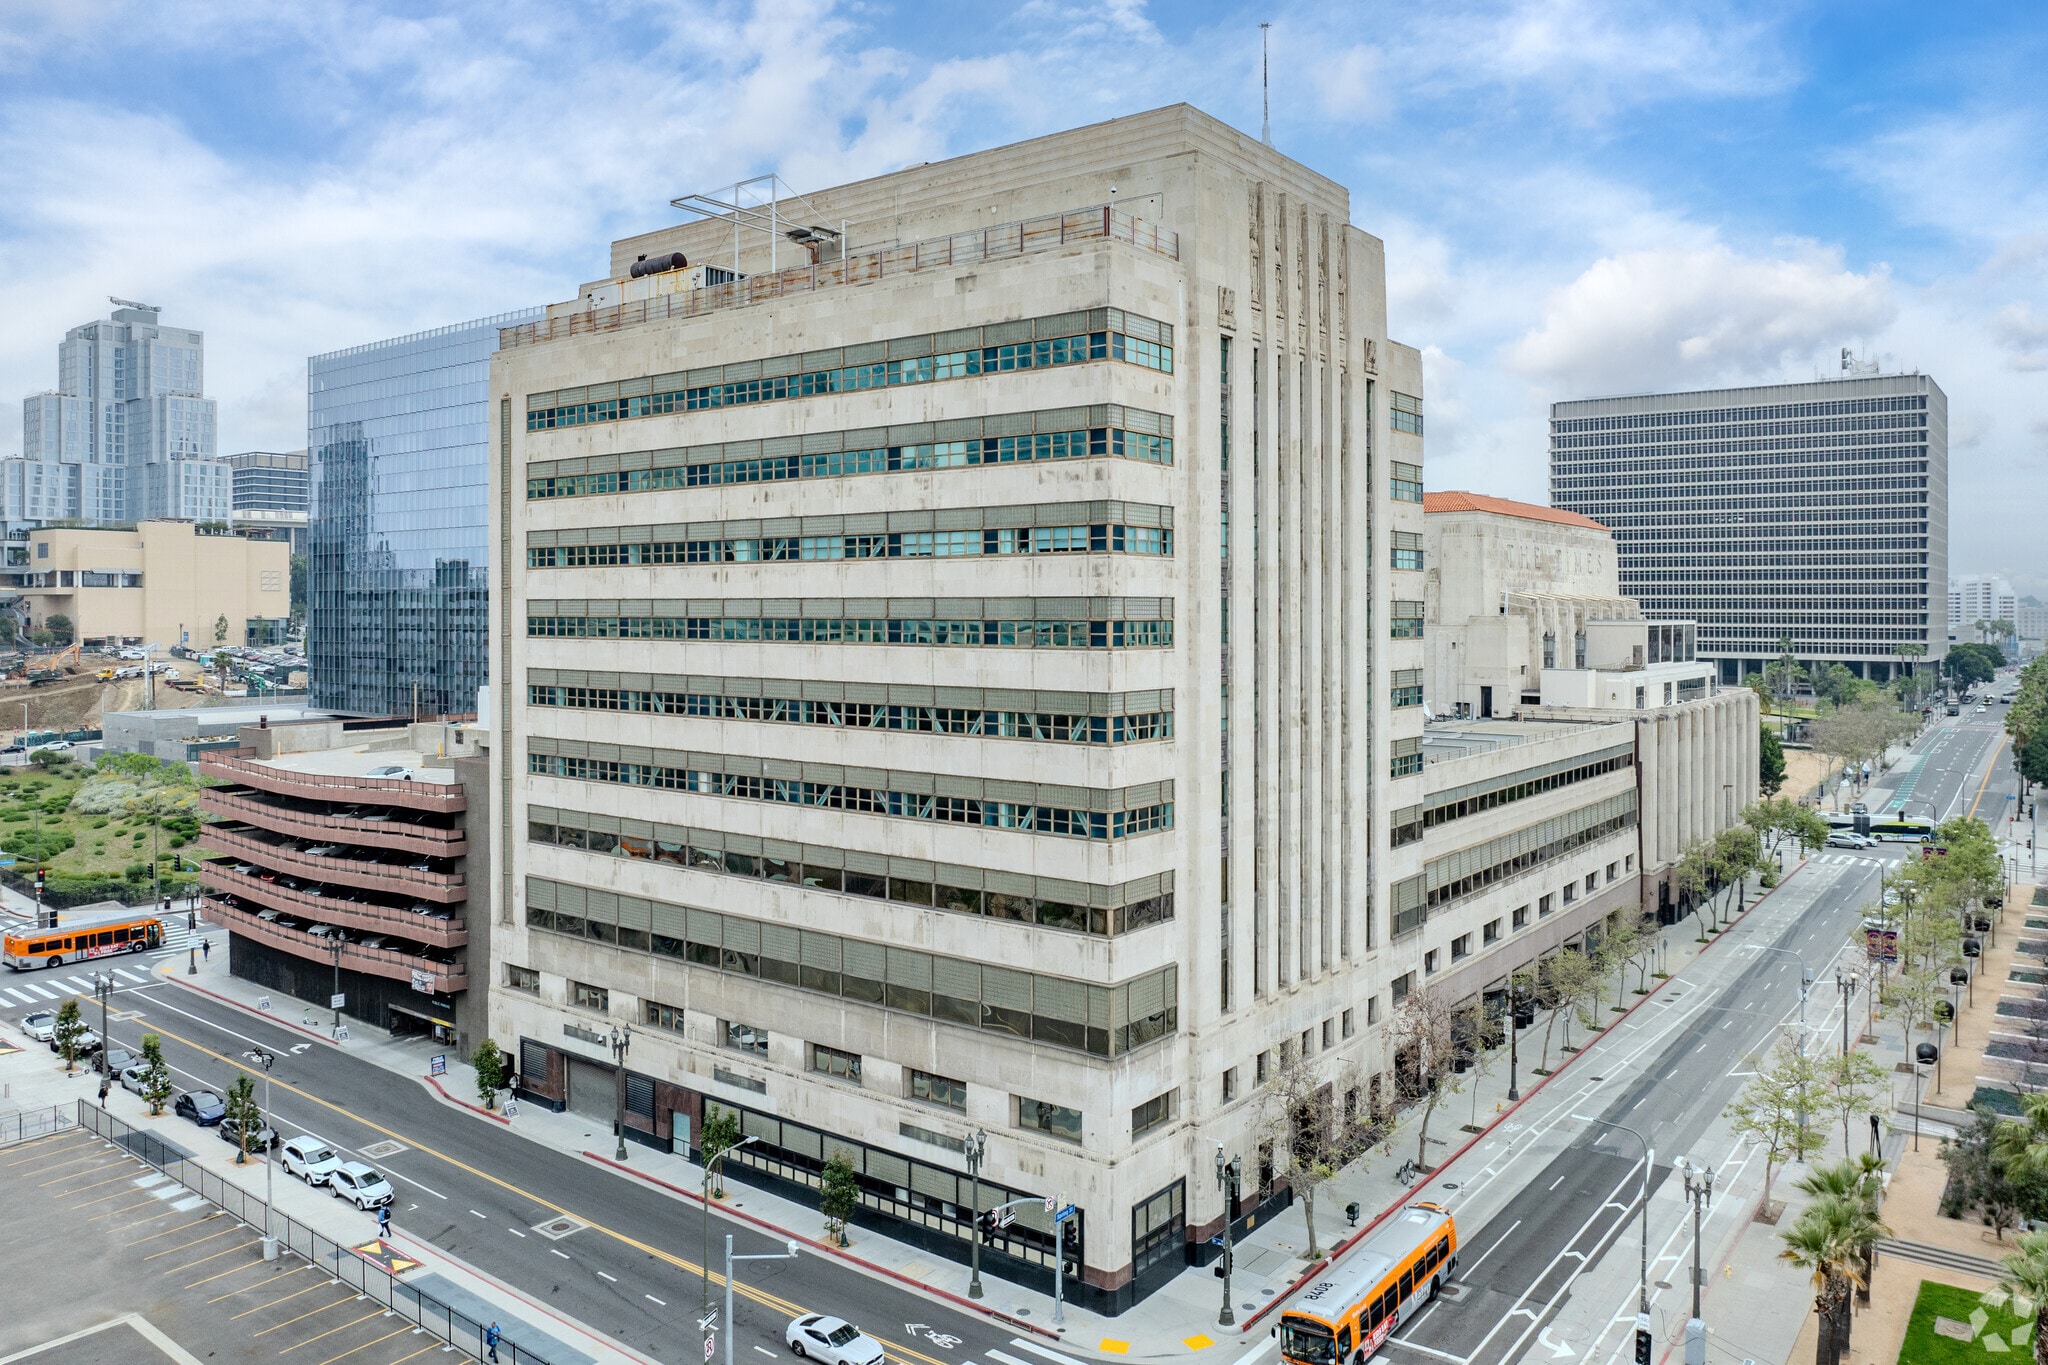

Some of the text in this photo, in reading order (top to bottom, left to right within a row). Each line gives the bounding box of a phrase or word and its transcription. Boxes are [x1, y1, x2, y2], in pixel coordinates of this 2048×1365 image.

[1506, 544, 1602, 575] THE TIMES
[1304, 1282, 1333, 1300] 8408
